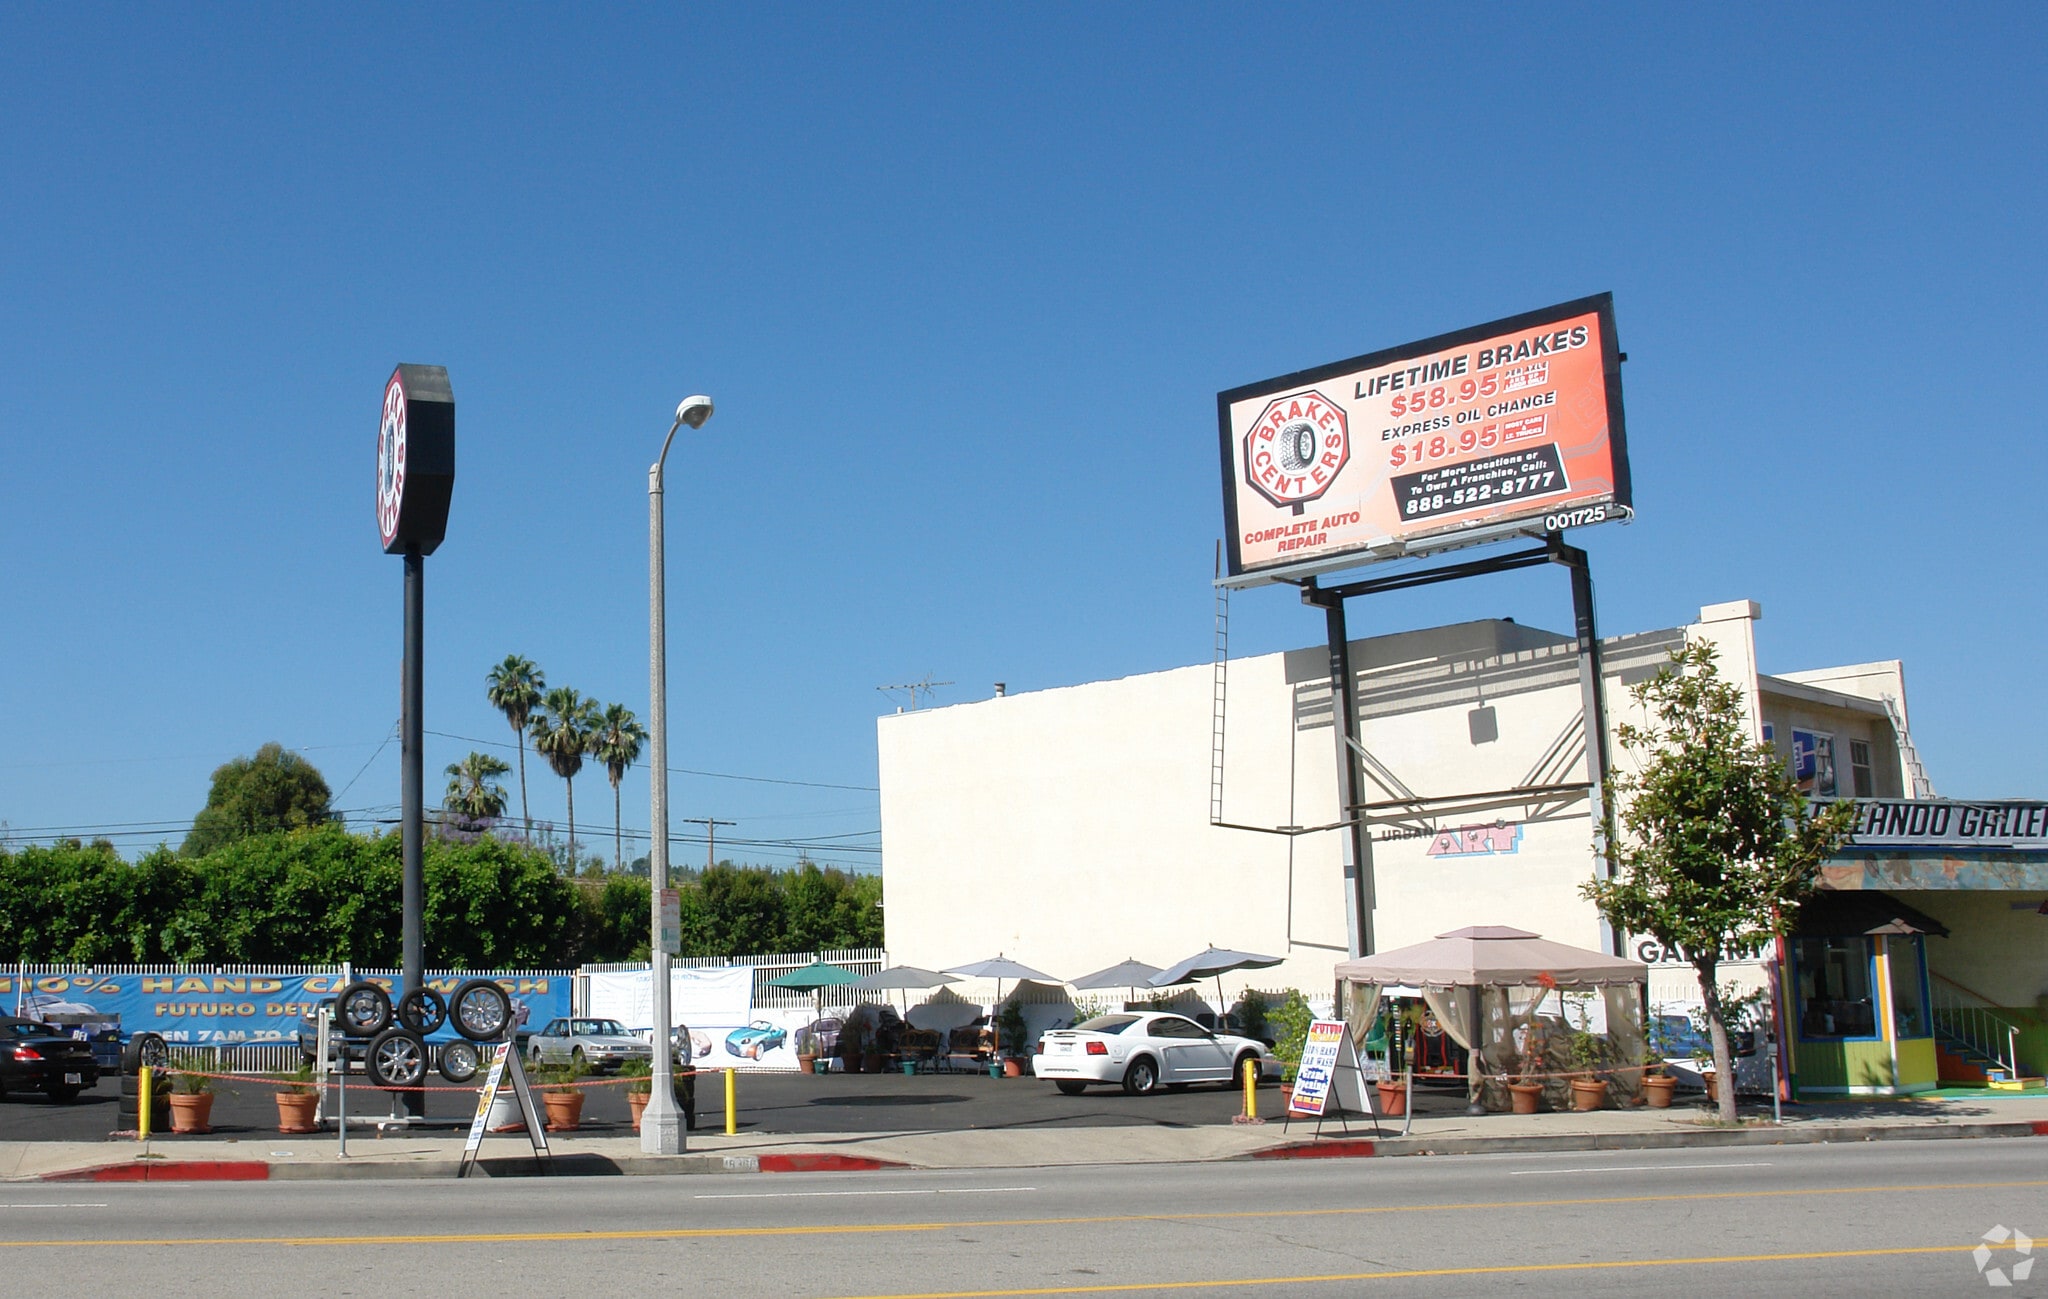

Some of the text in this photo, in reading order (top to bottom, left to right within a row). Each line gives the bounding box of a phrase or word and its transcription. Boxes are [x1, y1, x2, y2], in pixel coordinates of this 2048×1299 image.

[1354, 326, 1588, 400] LIFETIME BRAKES
[1391, 372, 1499, 419] $58.95
[1258, 400, 1336, 442] BRAKE
[1381, 391, 1556, 441] EXPRESS OIL CHANGE
[1255, 433, 1342, 494] CENTERS
[1390, 424, 1498, 469] $18.95
[1411, 460, 1547, 495] To Own A Franchise, Call:
[1421, 452, 1539, 483] For More Locations or
[1406, 470, 1555, 515] 888-522-8777
[1244, 511, 1360, 545] COMPLETE AUTO
[1545, 507, 1606, 531] 001725
[1277, 533, 1328, 552] REPAIR
[1381, 827, 1434, 842] URBAN
[1426, 823, 1524, 859] ART
[142, 977, 283, 994] HAND
[155, 1002, 257, 1017] FUTURO
[198, 1030, 246, 1042] 7AM
[253, 1030, 282, 1040] TO
